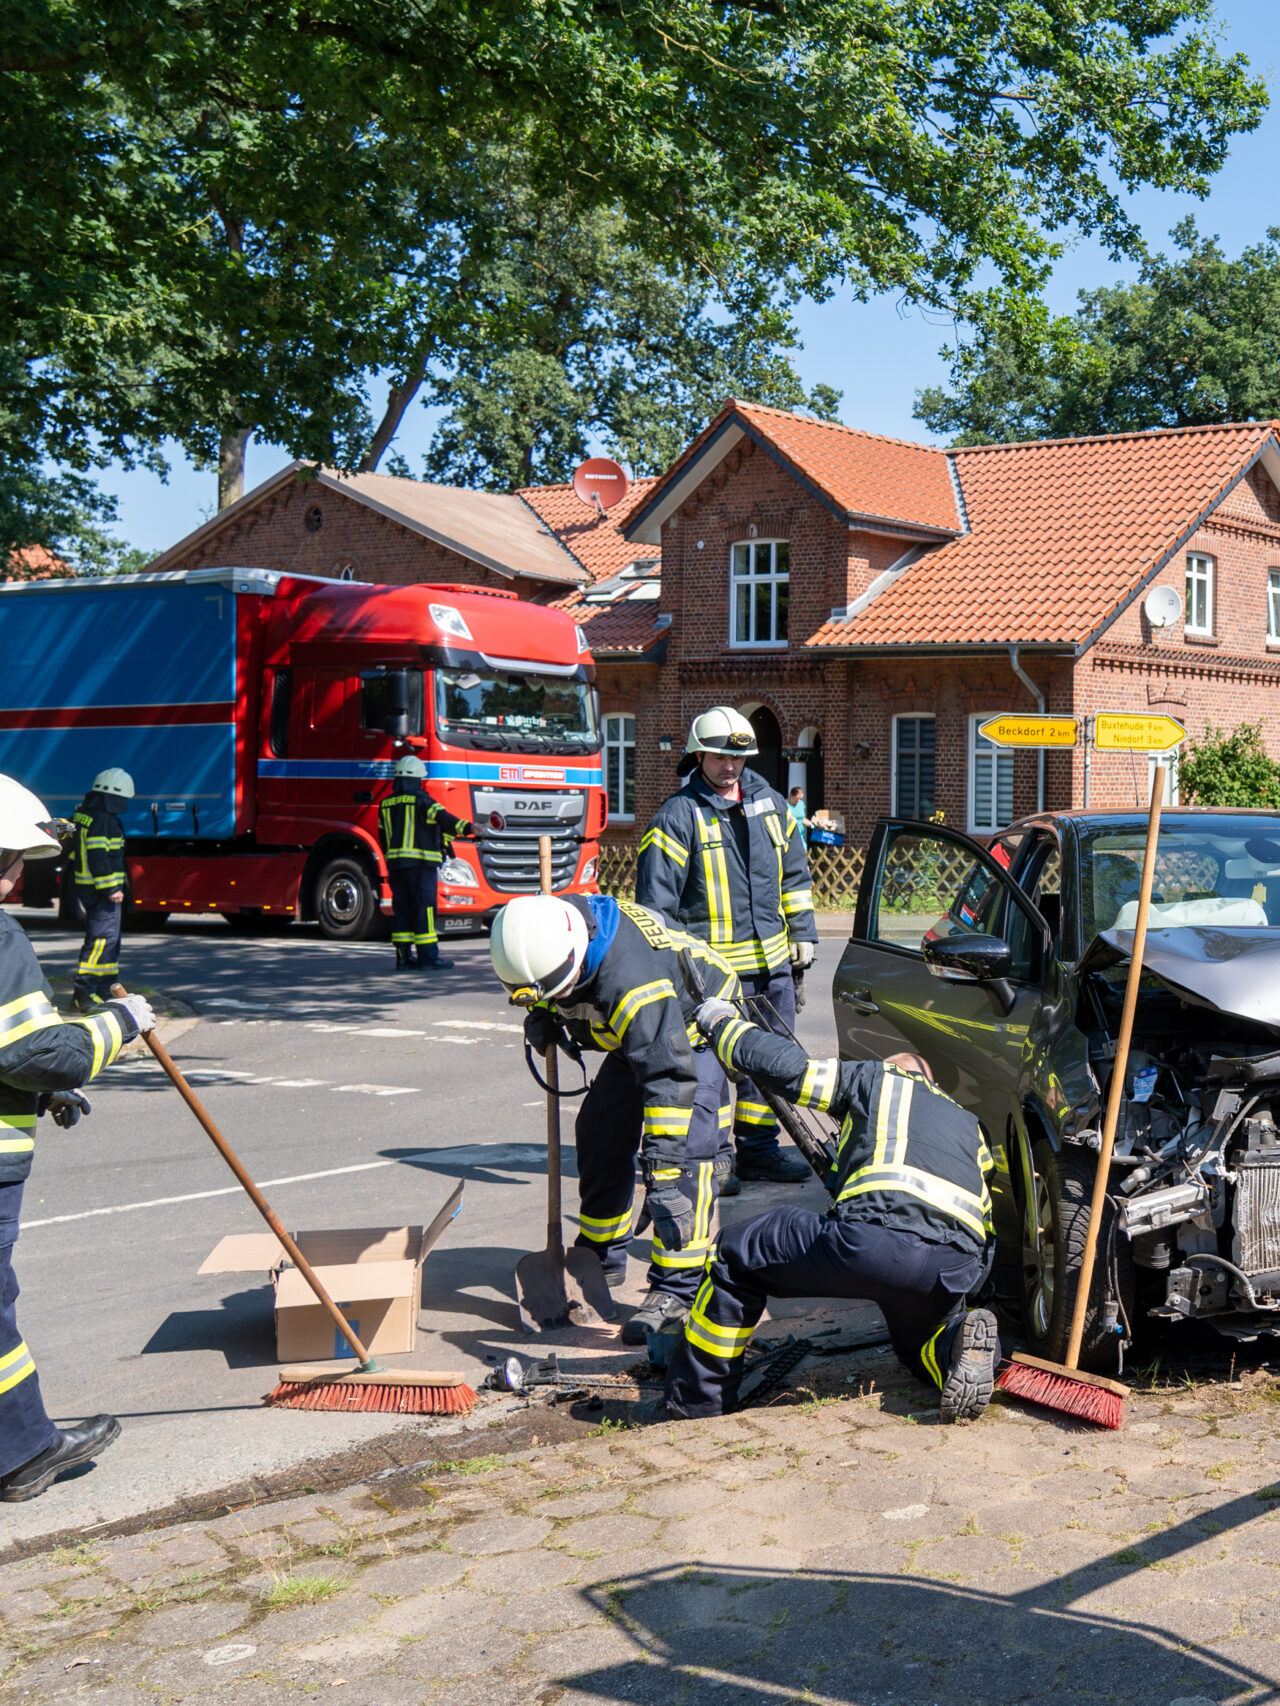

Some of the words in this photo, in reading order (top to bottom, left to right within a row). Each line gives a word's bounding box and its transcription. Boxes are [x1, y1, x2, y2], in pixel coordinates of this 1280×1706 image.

[1101, 720, 1144, 731] Buxtehude
[1147, 722, 1153, 730] 9
[998, 726, 1045, 736] Beckdorf
[1050, 728, 1055, 737] 2
[1113, 734, 1144, 744] Nindorf
[1147, 735, 1152, 744] 3
[514, 801, 552, 810] DAF
[444, 918, 473, 927] DAF
[619, 901, 671, 946] FEUER
